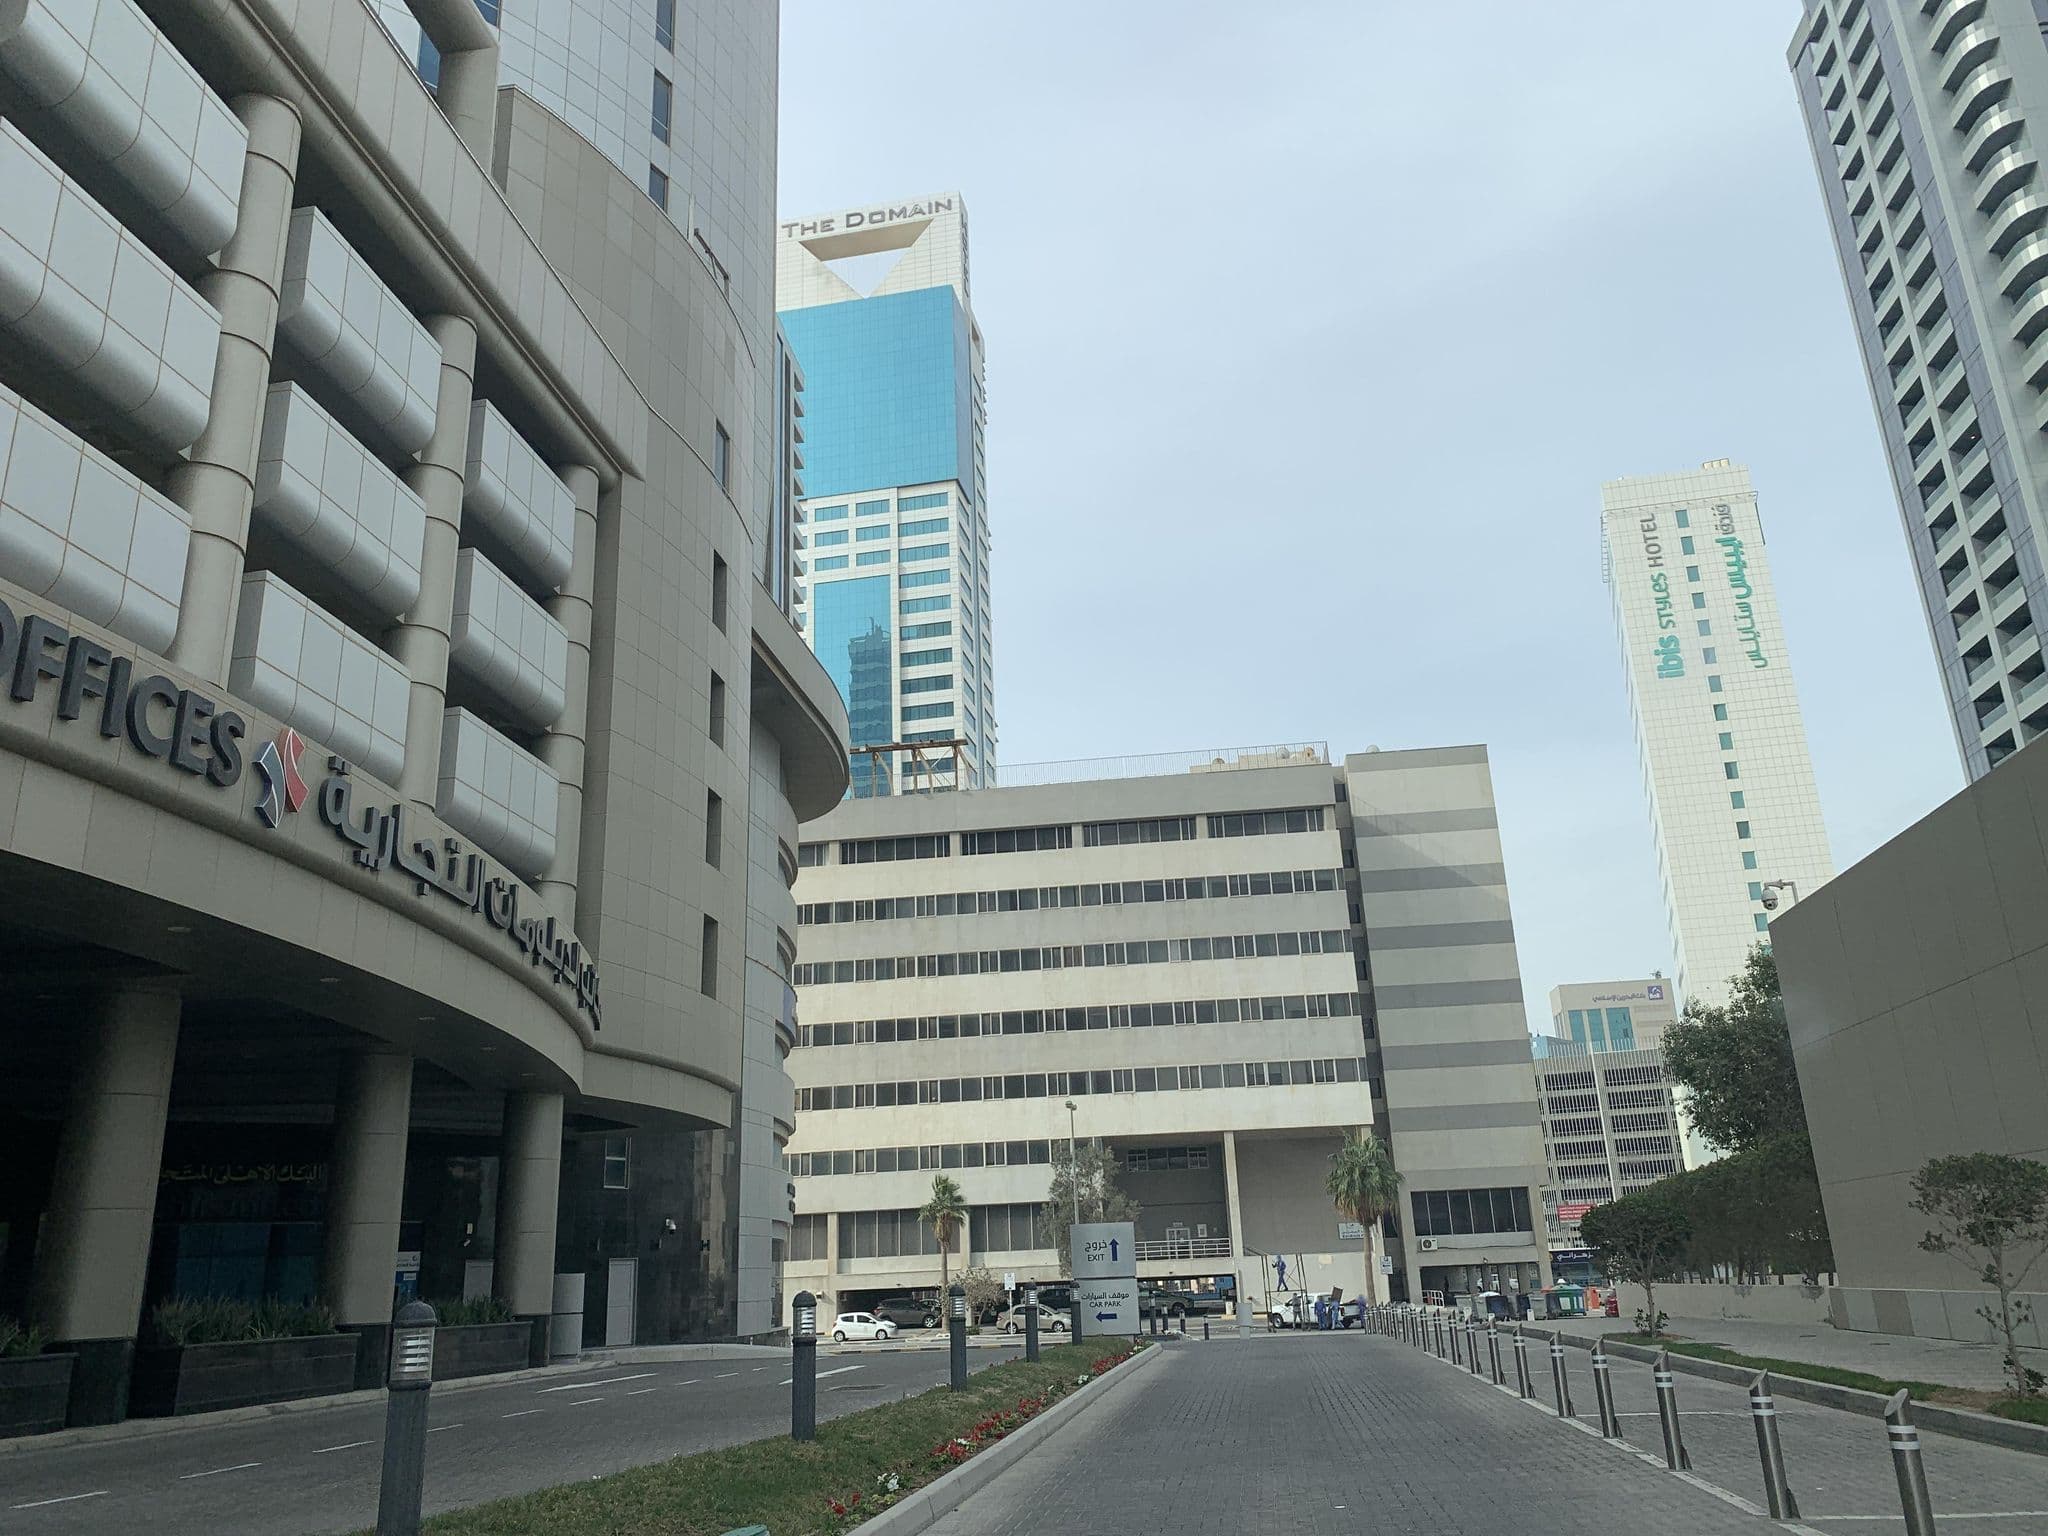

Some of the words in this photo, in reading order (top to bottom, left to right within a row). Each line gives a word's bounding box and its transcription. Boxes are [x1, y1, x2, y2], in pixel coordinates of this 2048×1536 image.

[781, 217, 835, 238] THE
[845, 198, 953, 228] DOMAIN
[1711, 503, 1736, 535] فندق
[1639, 513, 1664, 568] HOTEL
[1654, 634, 1685, 679] ibis
[318, 755, 487, 913] التجارية
[161, 1163, 213, 1185] المتح
[1084, 1239, 1108, 1252] خروج
[1087, 1253, 1105, 1262] EXIT
[1081, 1291, 1107, 1301] السيارات
[1104, 1300, 1122, 1308] PARK
[1108, 1292, 1130, 1300] موقف
